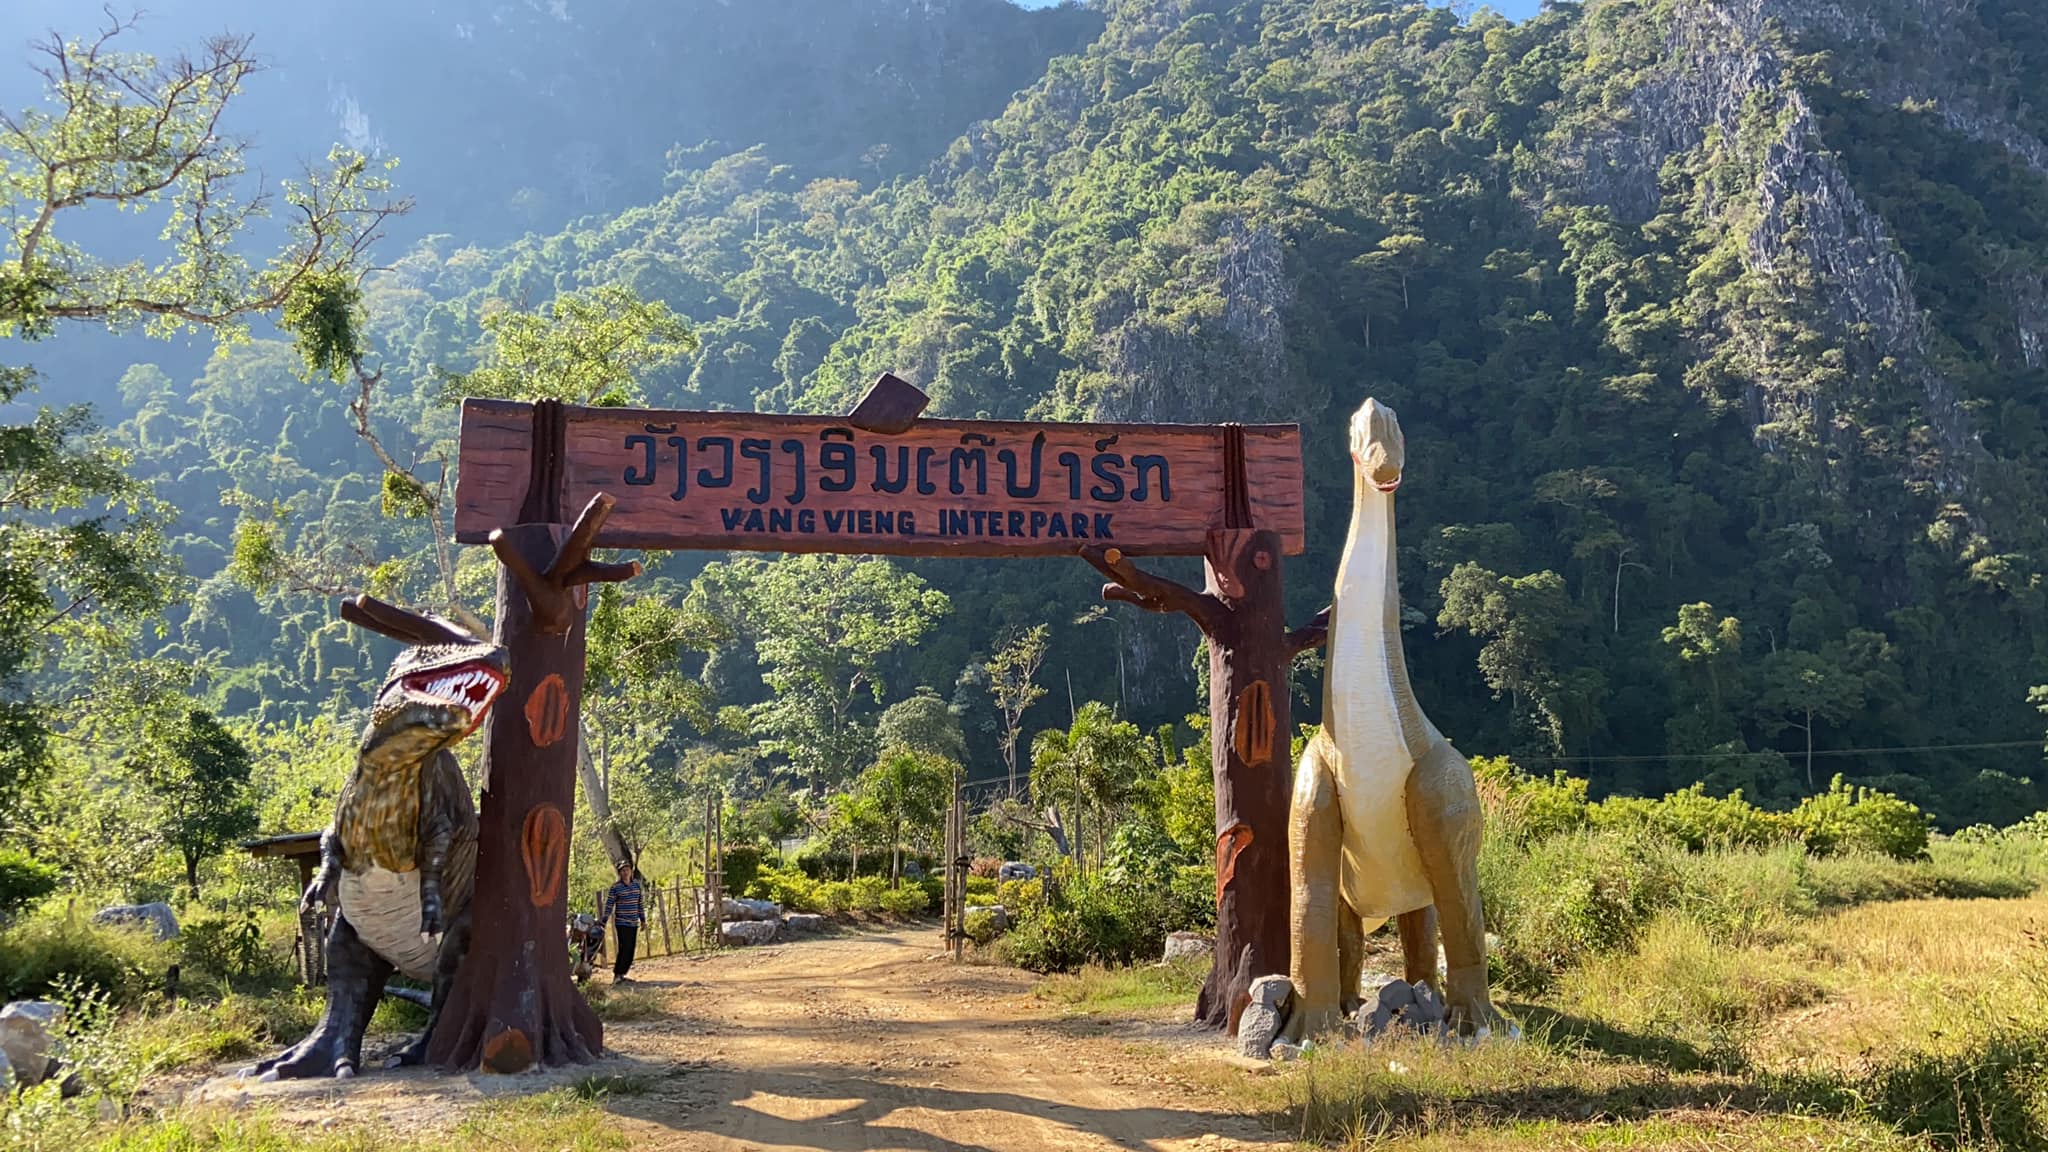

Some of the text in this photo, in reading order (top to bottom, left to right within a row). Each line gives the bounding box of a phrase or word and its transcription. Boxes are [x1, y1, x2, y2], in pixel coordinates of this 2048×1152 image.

[720, 508, 1114, 539] VANG VIENG INTERPARK
